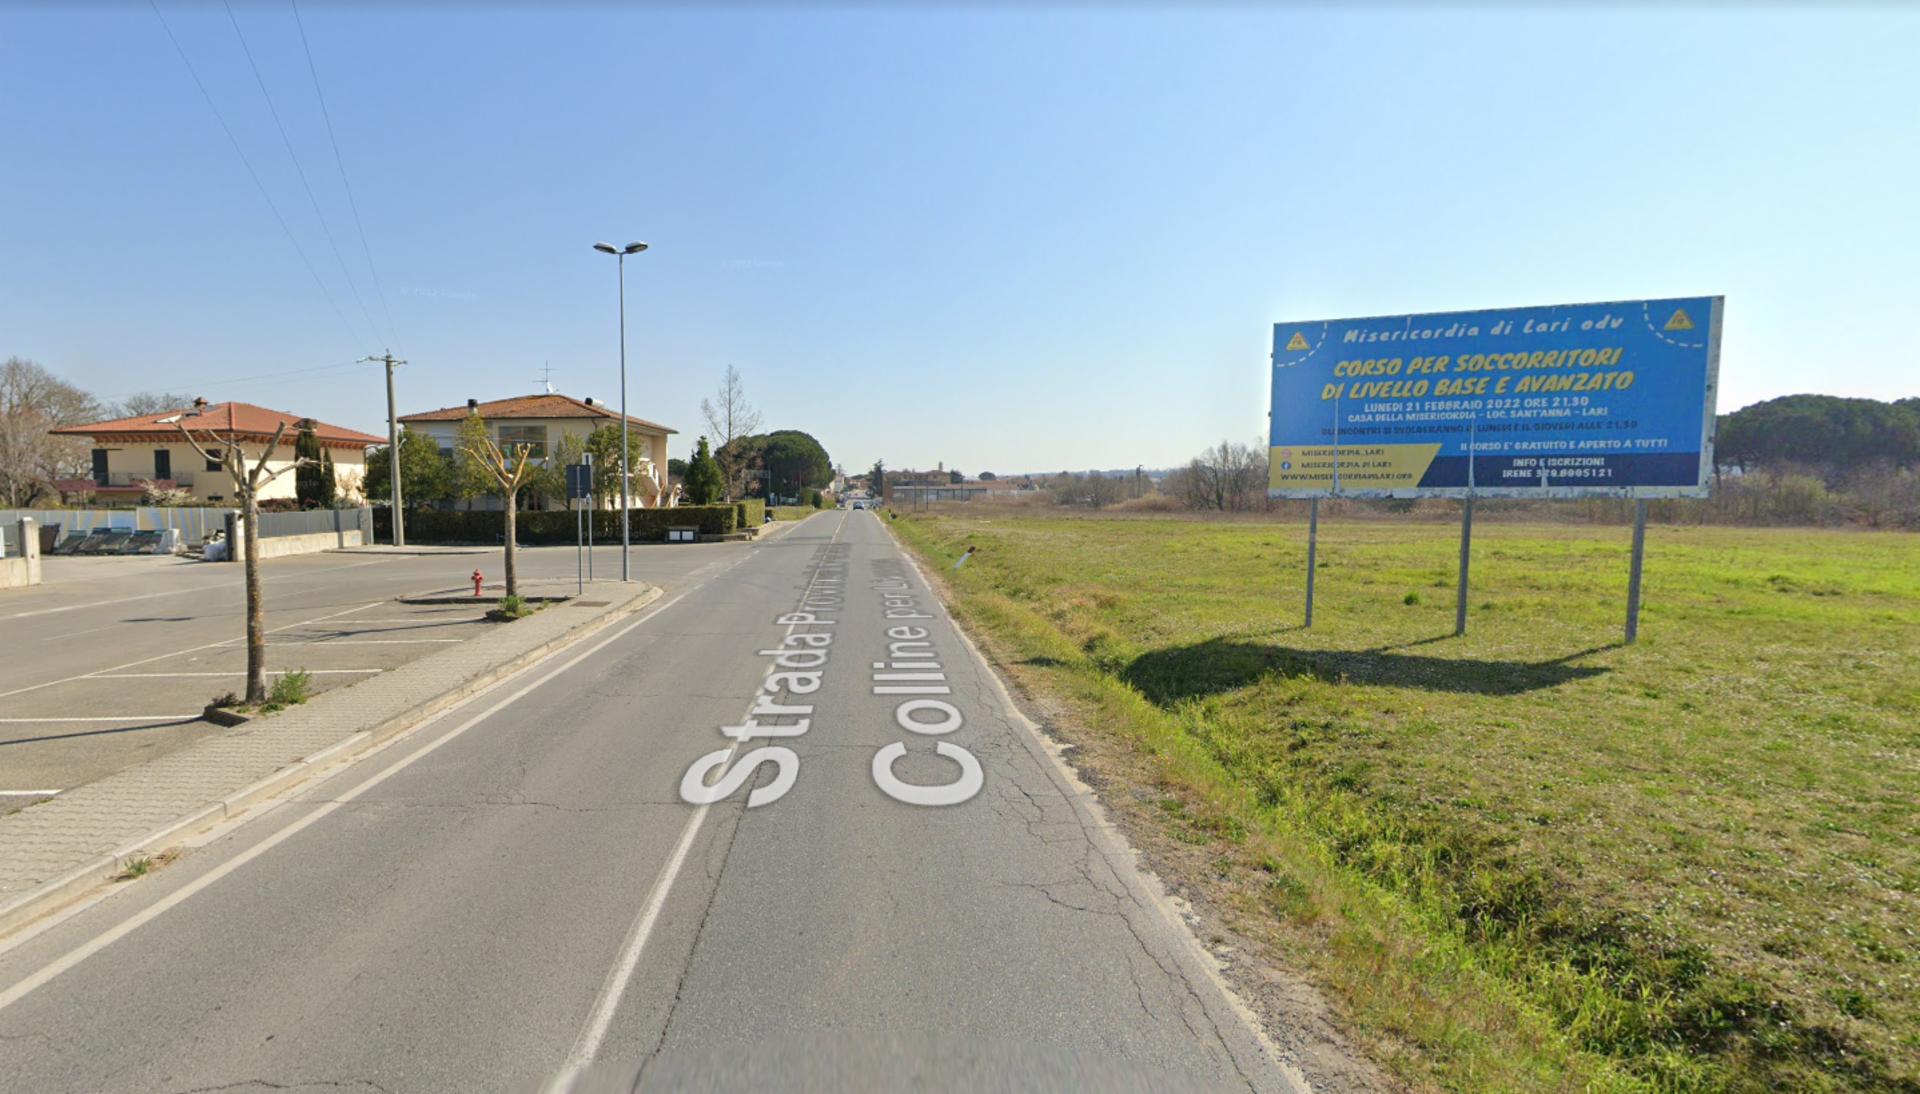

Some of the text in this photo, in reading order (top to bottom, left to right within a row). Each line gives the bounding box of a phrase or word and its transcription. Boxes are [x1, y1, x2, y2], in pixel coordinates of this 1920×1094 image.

[1343, 314, 1624, 343] Misericordia di Lari odv
[1333, 347, 1624, 378] CORSO PER SOCCORRITORI
[1321, 371, 1635, 400] DI LIVELLO BASE E AVANZATO
[1405, 402, 1421, 412] 21
[1424, 399, 1483, 411] FEBBRAIO
[1486, 398, 1521, 410] 2022
[1523, 397, 1549, 408] ORE
[1552, 396, 1590, 407] 21.30
[1347, 414, 1374, 423] CASA
[1375, 413, 1404, 422] DELLA
[1405, 411, 1476, 421] MISERICORDIA
[1582, 406, 1609, 417] LARI
[1469, 441, 1501, 451] CORSO
[1514, 440, 1567, 450] GRATUITO
[1577, 439, 1621, 449] APERTO
[1623, 439, 1632, 448] A
[1633, 438, 1668, 448] TUTTI
[1513, 458, 1537, 467] INFO
[1547, 457, 1605, 466] ISCRIZIONI
[1502, 470, 1532, 478] IRENE
